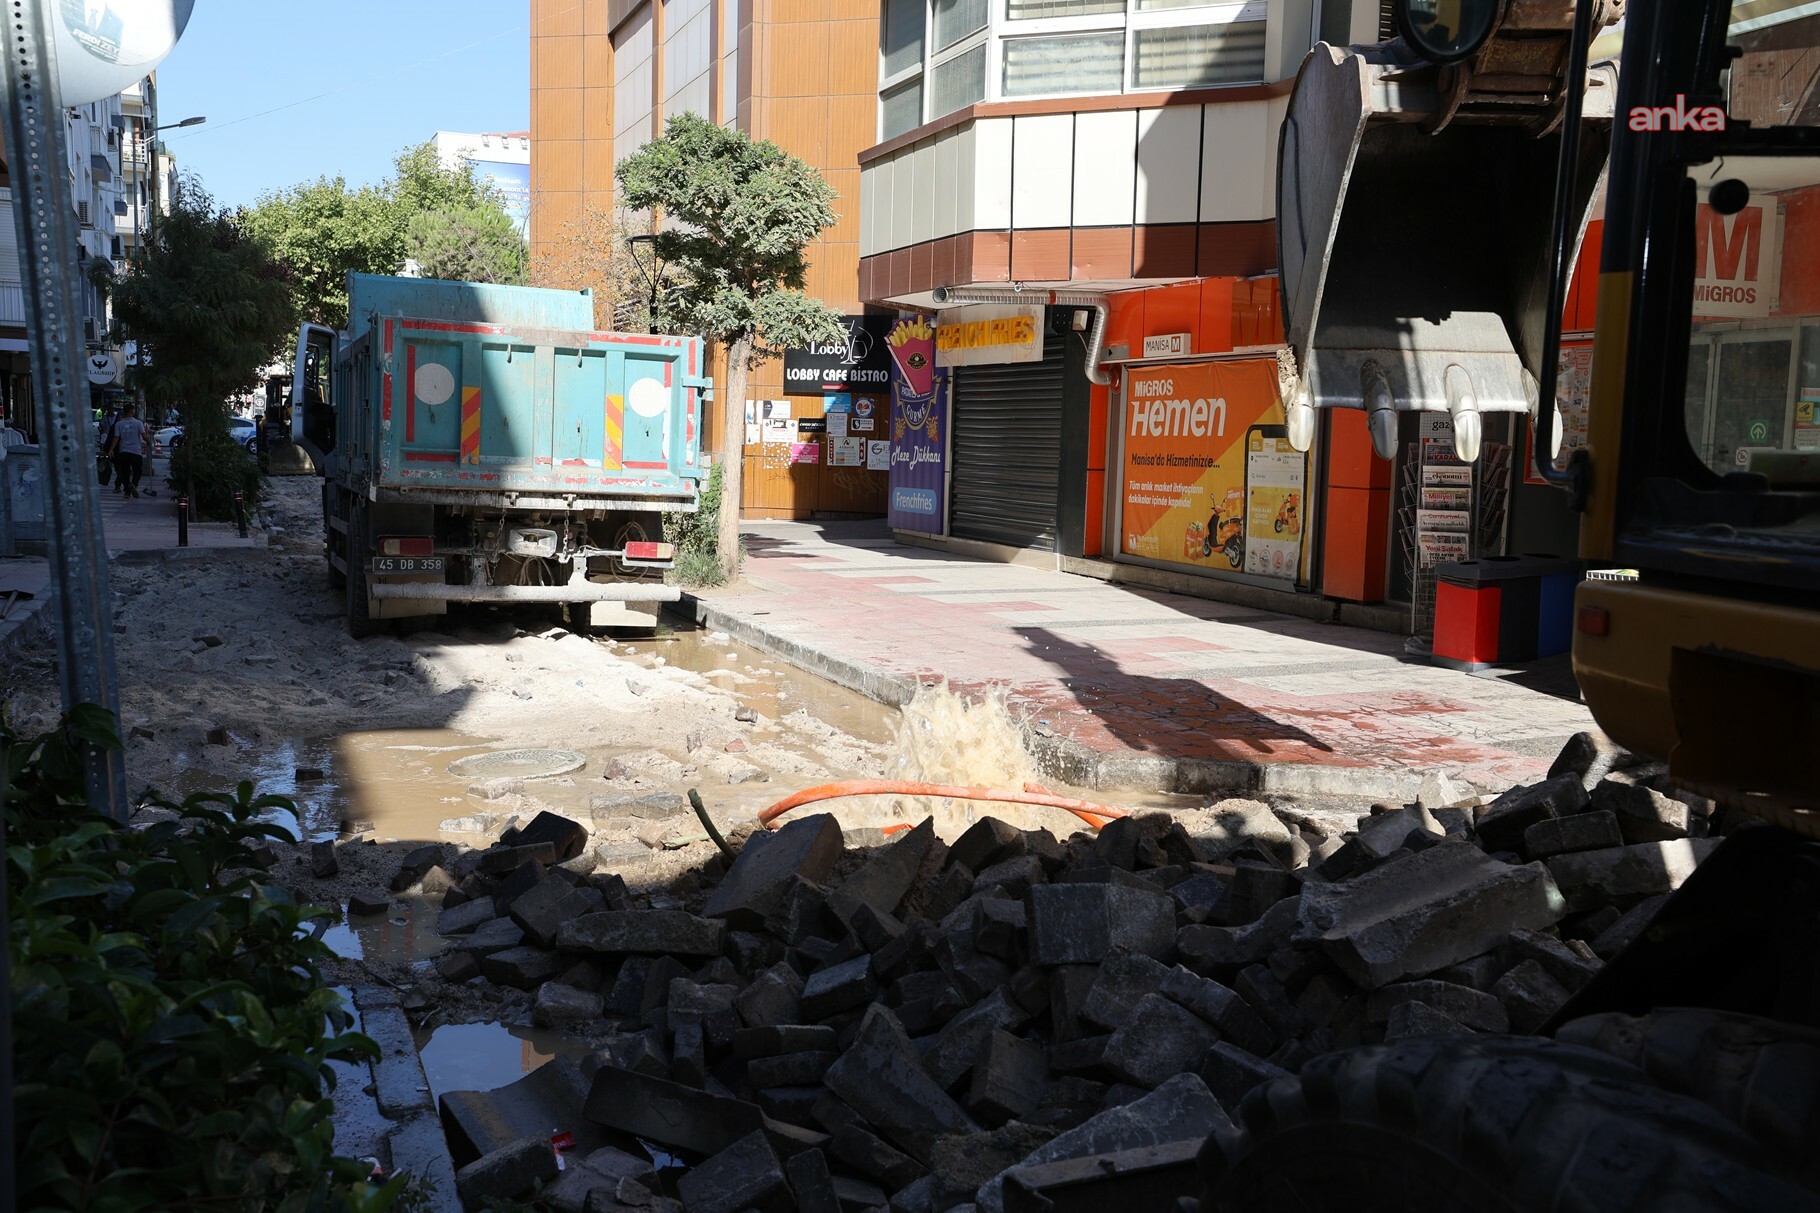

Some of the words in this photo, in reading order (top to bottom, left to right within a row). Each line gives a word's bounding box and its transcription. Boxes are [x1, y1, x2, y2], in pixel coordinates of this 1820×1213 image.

[1696, 203, 1763, 282] M
[937, 321, 991, 350] FRENCH
[991, 315, 1035, 345] FRIES
[810, 340, 849, 360] Lobby
[1145, 338, 1170, 351] MANİSA
[786, 368, 821, 381] LOBBY
[822, 369, 848, 381] CAFE
[850, 366, 889, 382] BİSTRO
[1131, 397, 1227, 437] Hemen
[1431, 421, 1450, 432] gaz
[891, 445, 910, 466] Meze
[909, 445, 941, 471] Dükkanı
[1131, 453, 1165, 466] Manisa'da
[1129, 480, 1140, 490] Tüm
[1154, 482, 1173, 492] market
[896, 492, 933, 511] Frenchfries
[379, 559, 394, 570] 45
[400, 559, 414, 570] DB
[420, 559, 442, 570] 358
